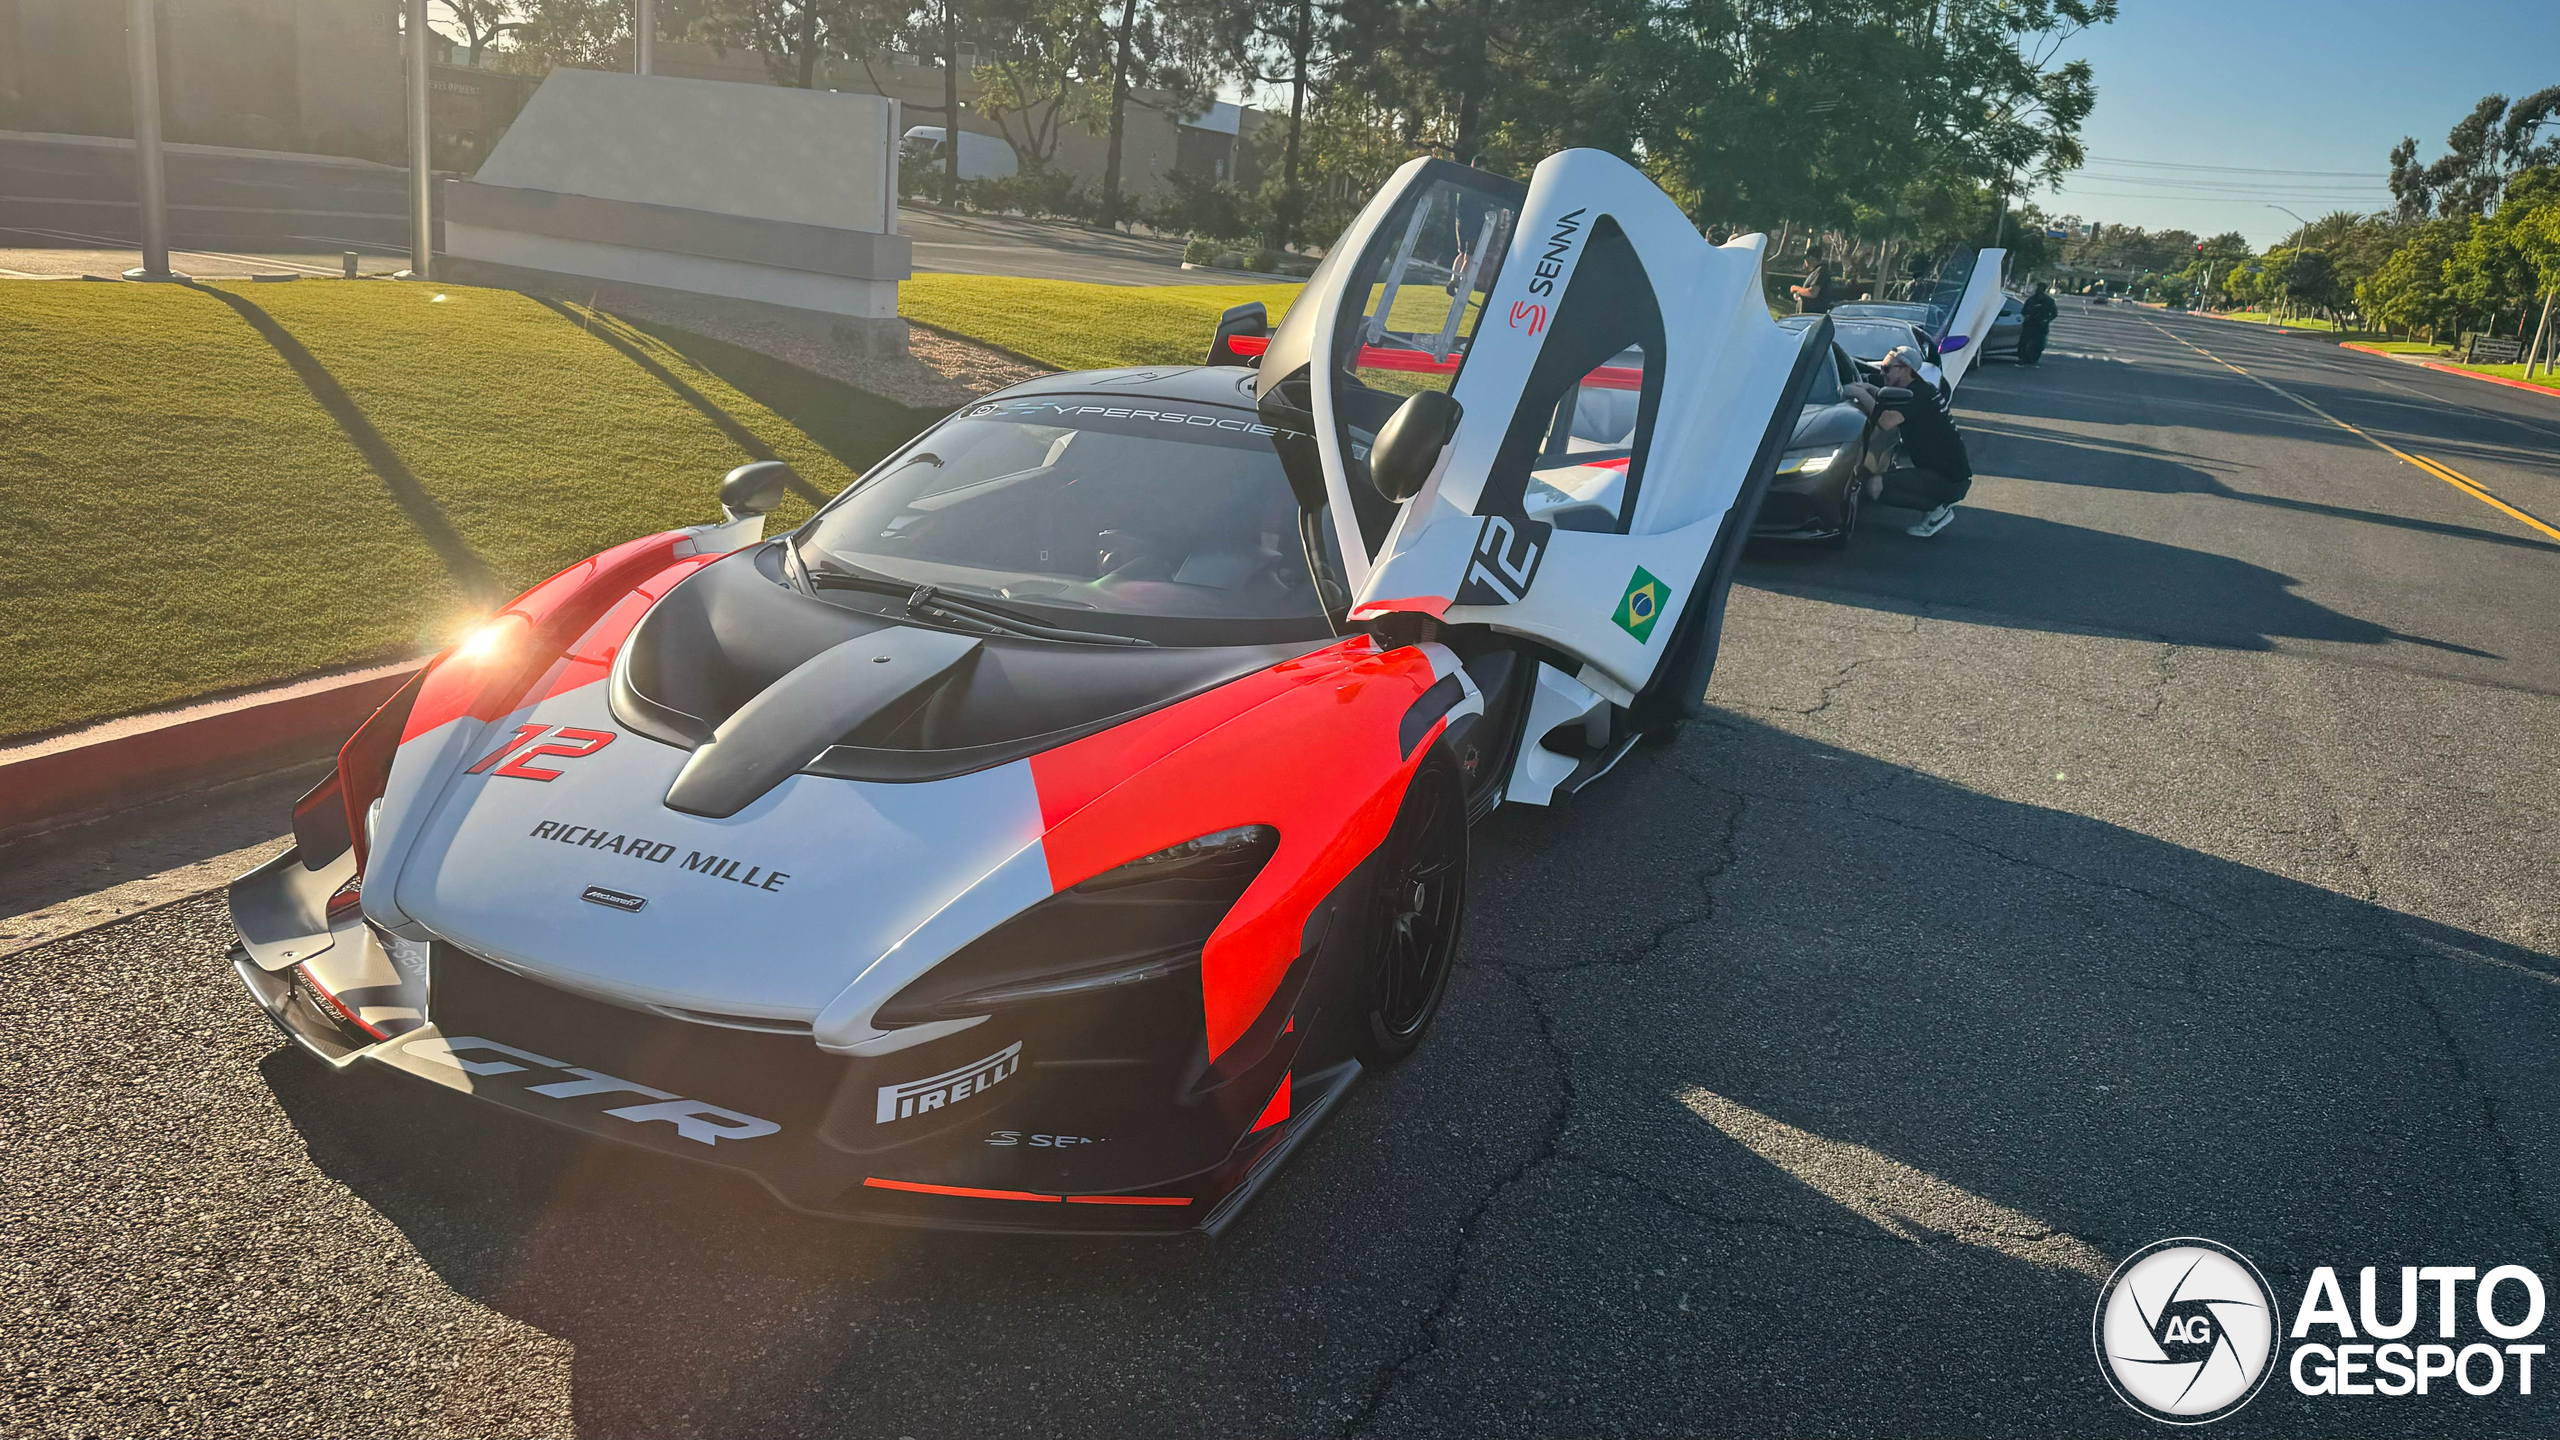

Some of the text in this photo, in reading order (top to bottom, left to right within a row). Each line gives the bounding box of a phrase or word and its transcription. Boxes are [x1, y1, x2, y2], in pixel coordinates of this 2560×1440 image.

[428, 80, 481, 95] EVELOPMENT
[1529, 208, 1586, 297] SENNA
[1468, 515, 1538, 604] 12
[464, 723, 617, 782] 12
[530, 820, 790, 892] RICHARD MILLE
[402, 1036, 781, 1146] GTR
[877, 1040, 1023, 1124] PIRELLI
